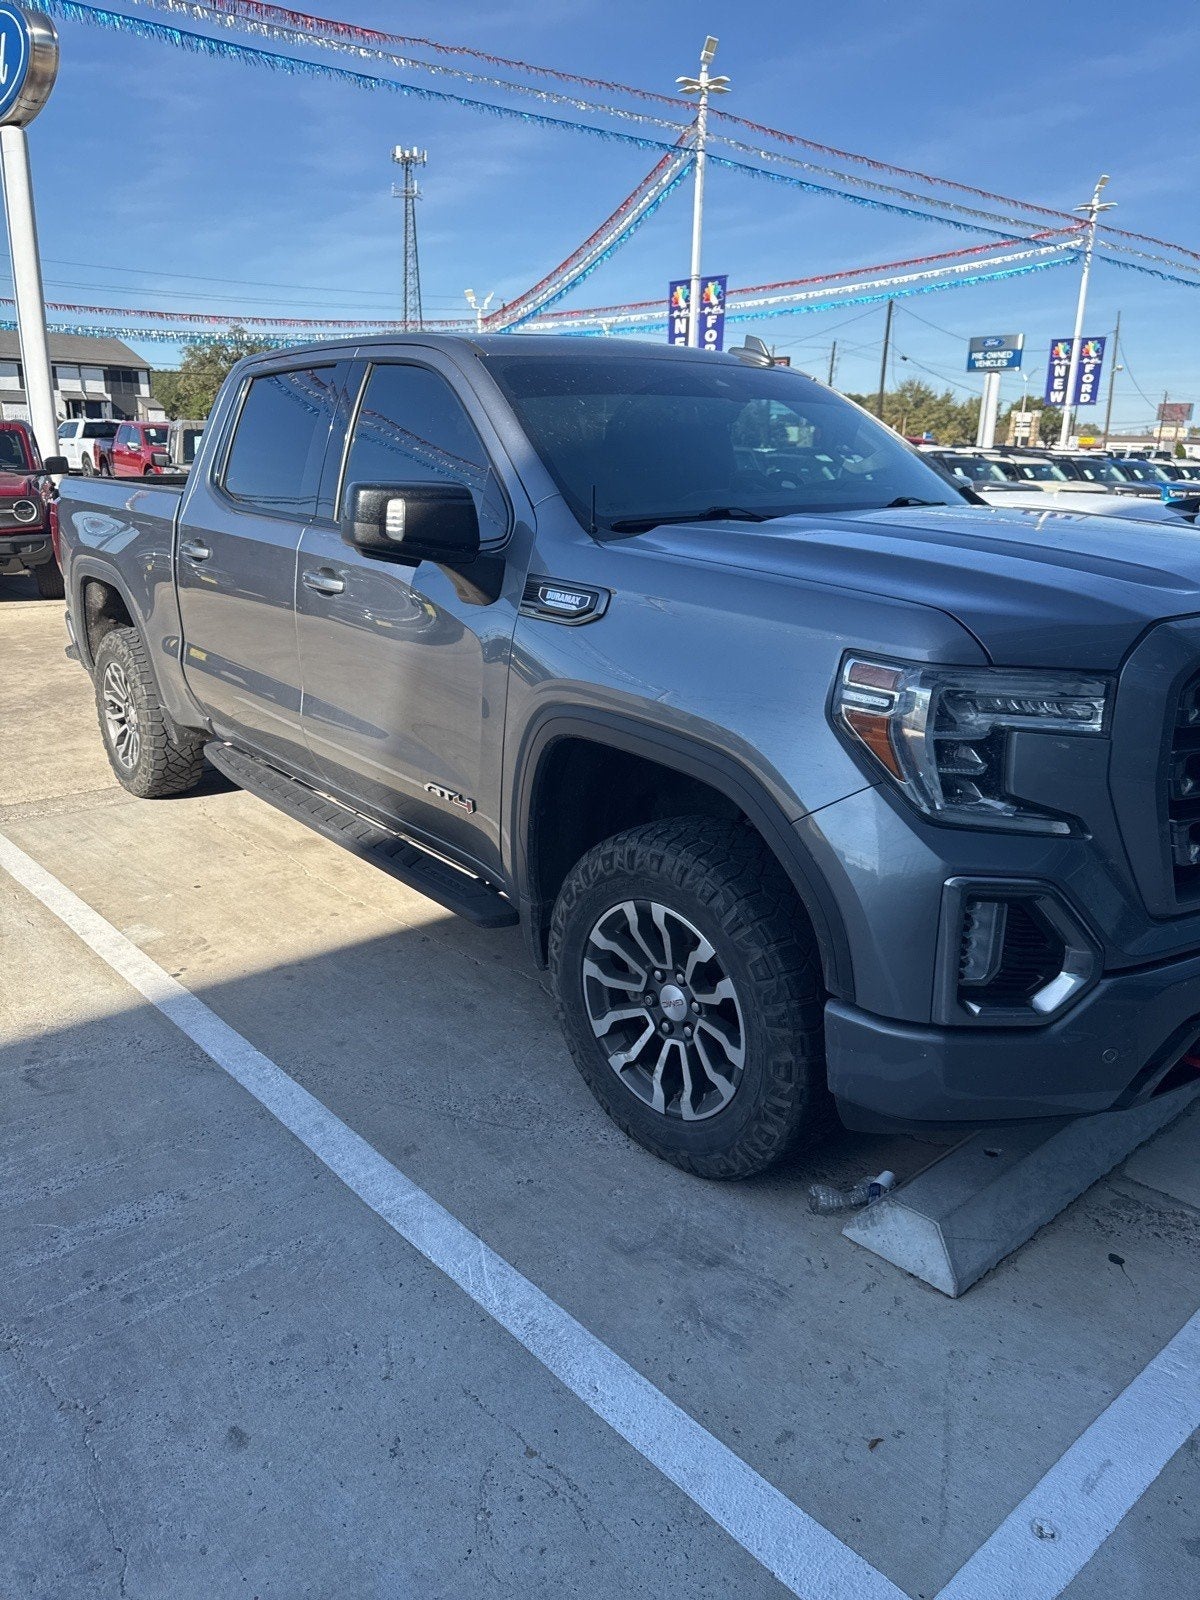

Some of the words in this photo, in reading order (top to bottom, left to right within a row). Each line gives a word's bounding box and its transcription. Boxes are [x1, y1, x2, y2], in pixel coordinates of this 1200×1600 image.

[971, 351, 1013, 360] PRE-OWNED
[975, 359, 1008, 367] VEHICLES
[1050, 365, 1066, 402] NEW
[1080, 364, 1095, 402] FORD
[546, 591, 581, 605] DURAMAX
[424, 782, 475, 814] AT4
